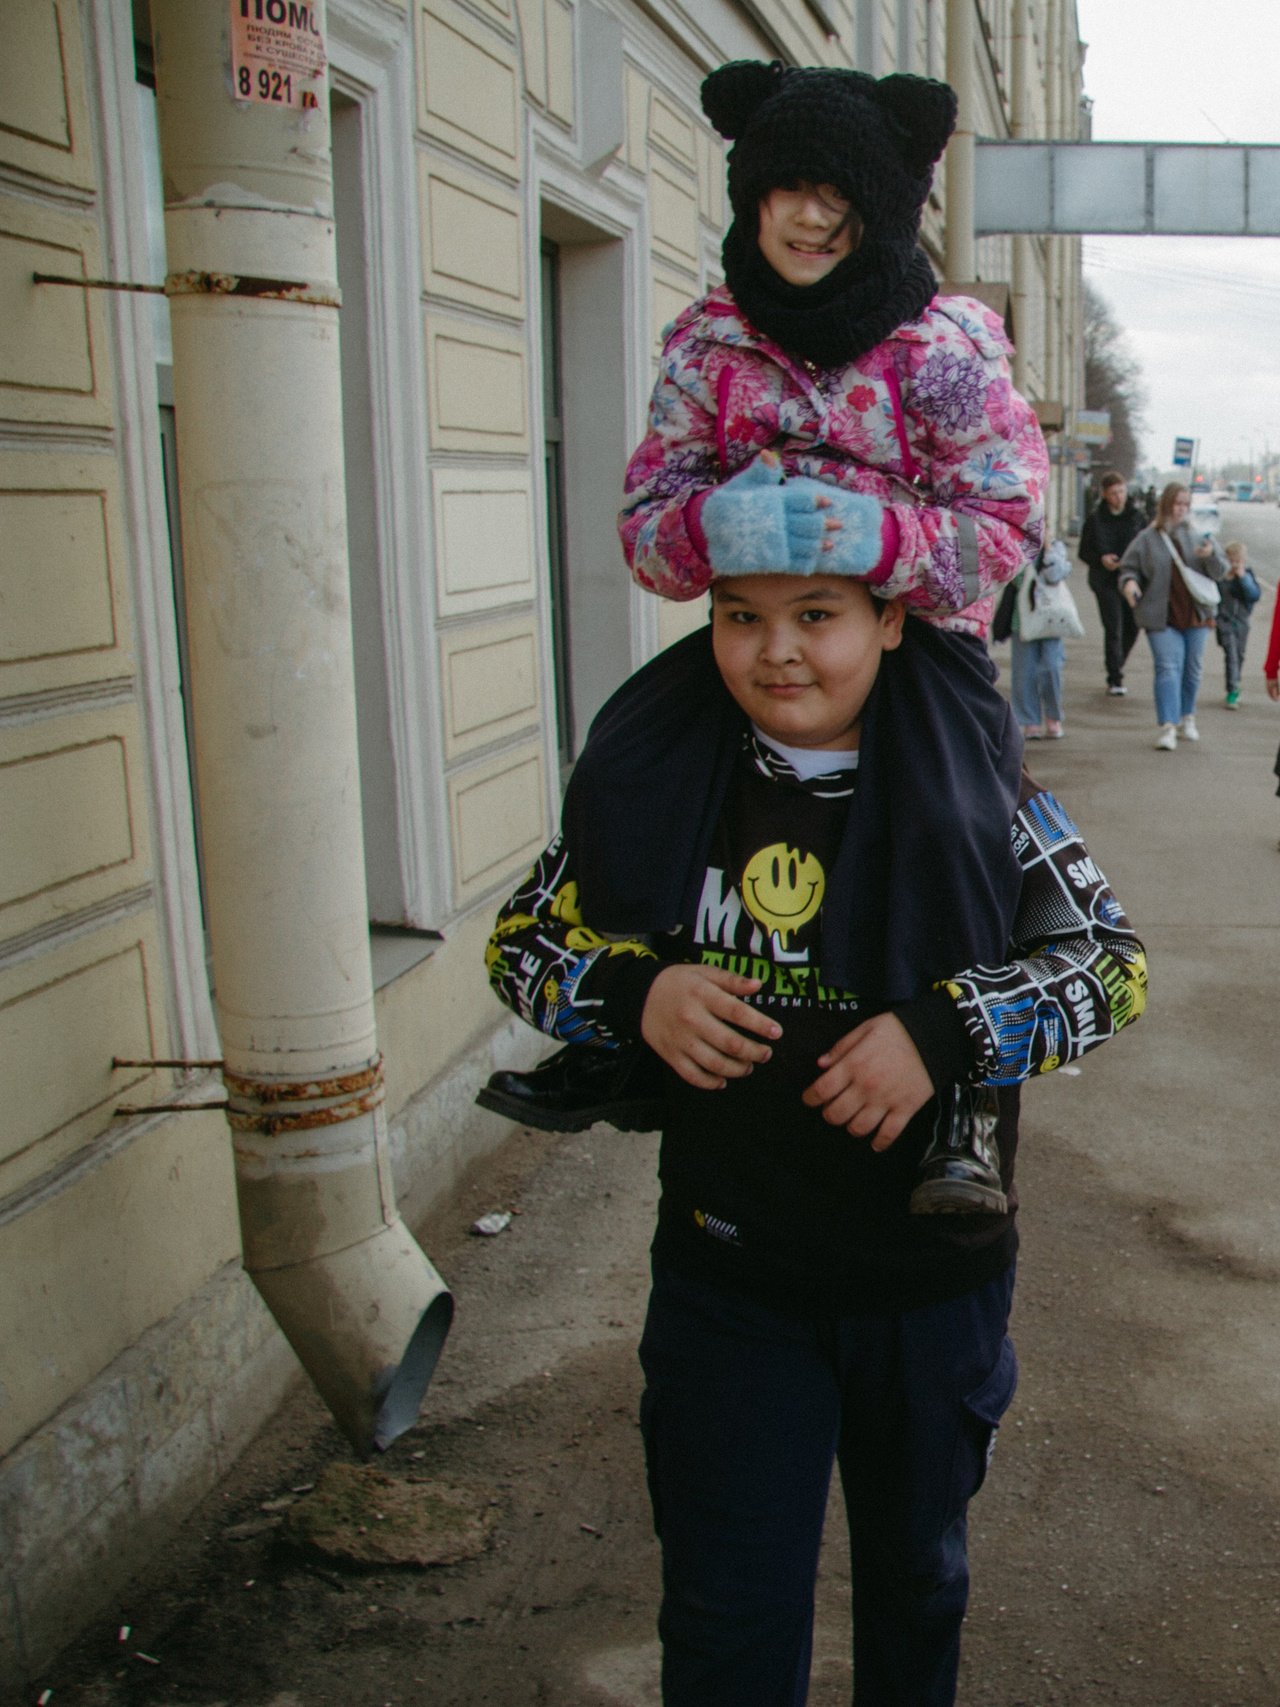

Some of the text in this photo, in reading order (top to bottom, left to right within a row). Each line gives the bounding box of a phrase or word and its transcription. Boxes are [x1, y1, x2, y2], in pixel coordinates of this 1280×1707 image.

[239, 66, 292, 103] 8 921
[1067, 856, 1106, 889] SM
